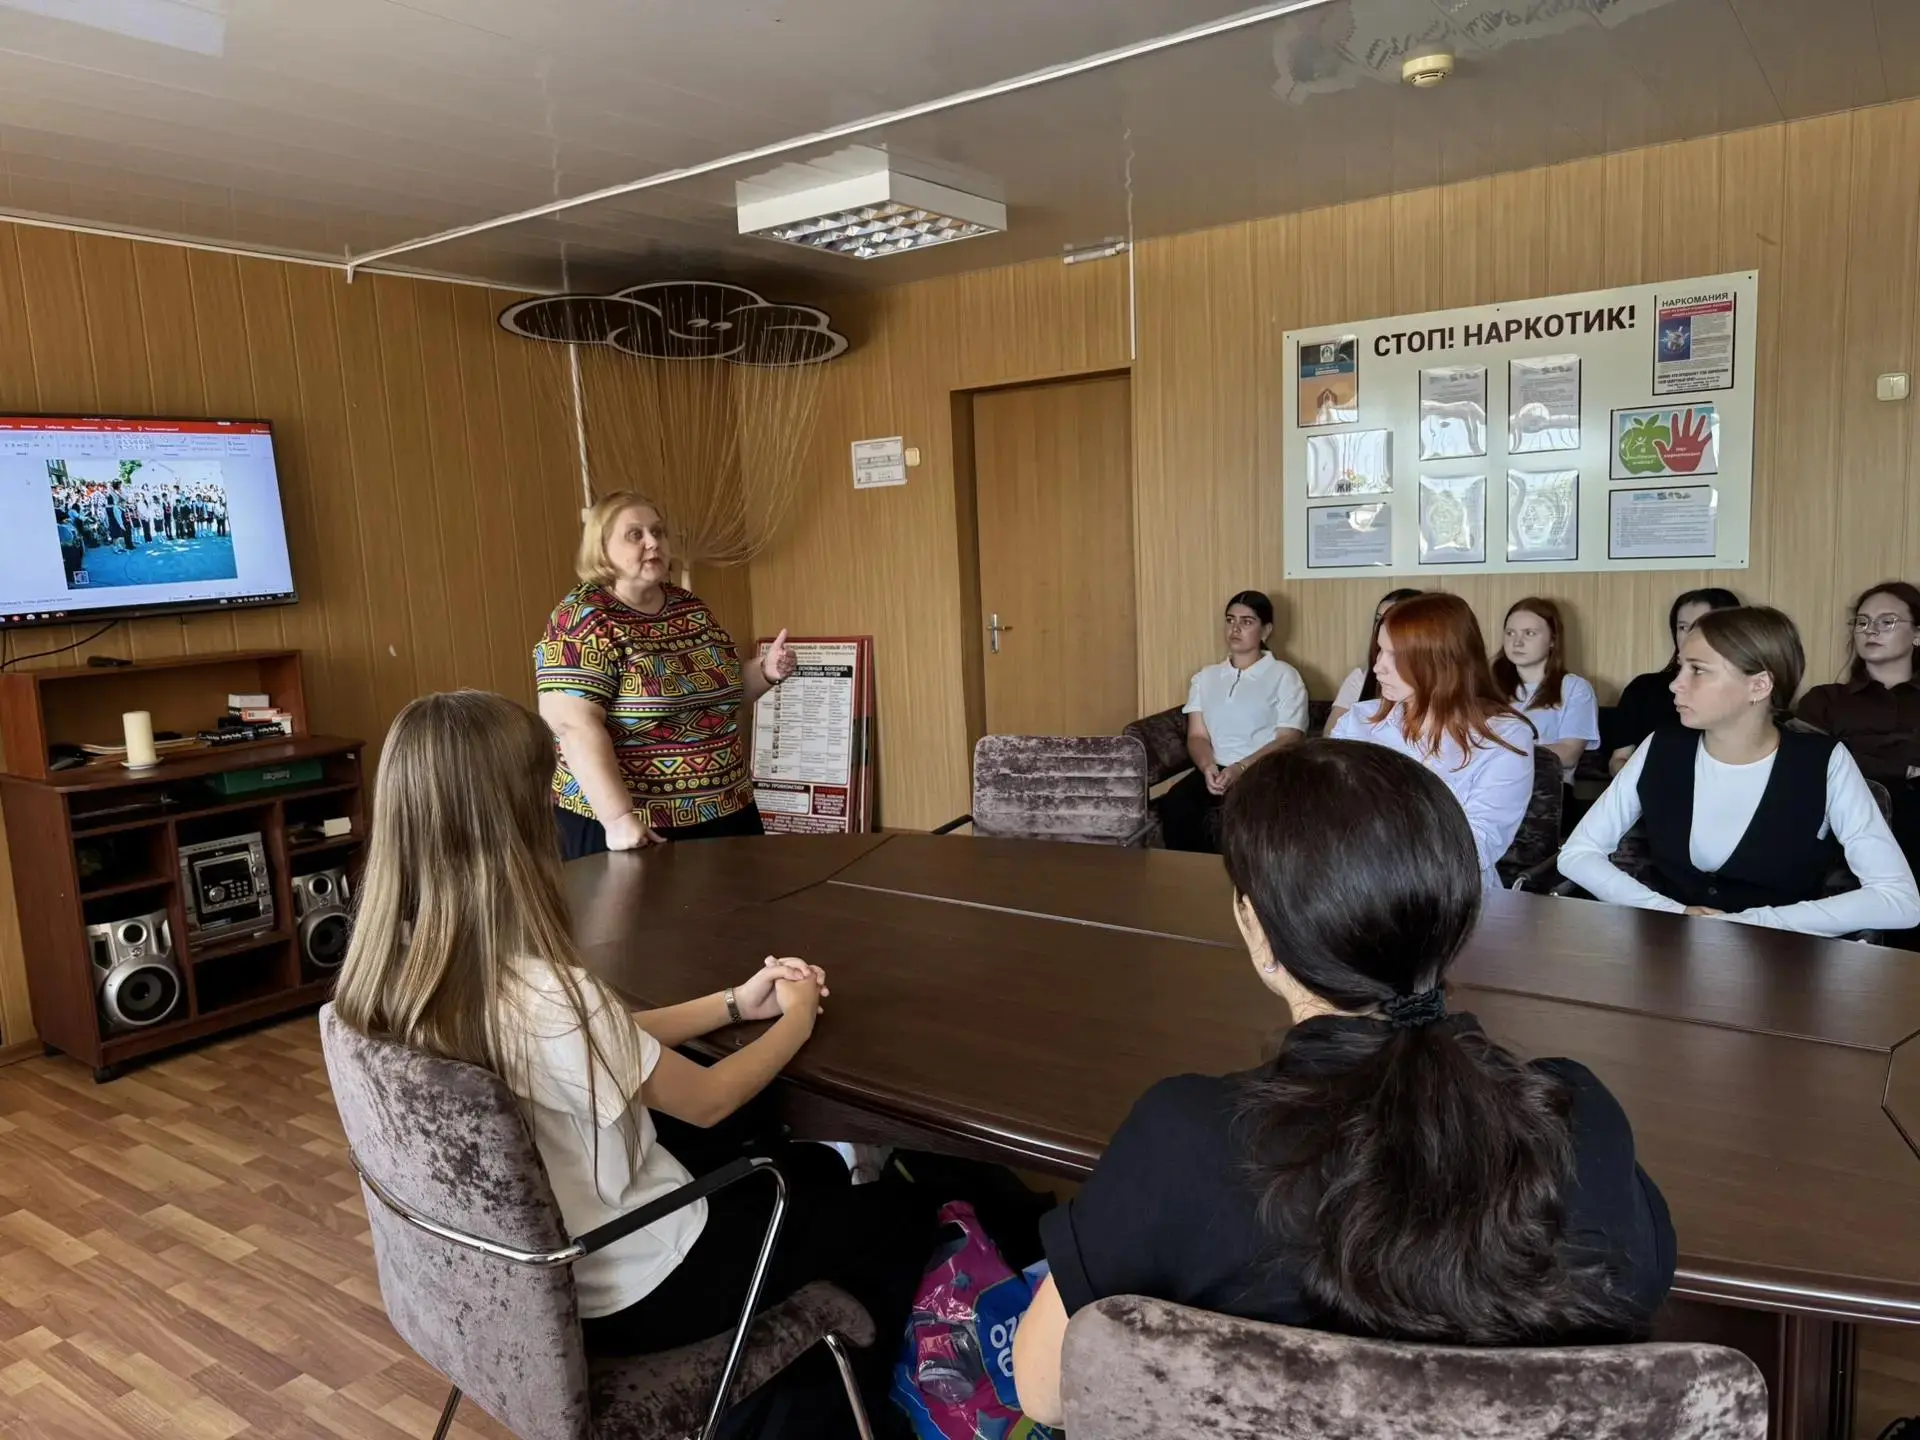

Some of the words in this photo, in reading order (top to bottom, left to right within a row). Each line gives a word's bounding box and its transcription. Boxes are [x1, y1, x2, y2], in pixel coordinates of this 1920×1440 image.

[1662, 292, 1729, 308] НАРКОМАНИЯ
[1374, 326, 1454, 357] СТОП!
[1464, 305, 1635, 347] НАРКОТИК!
